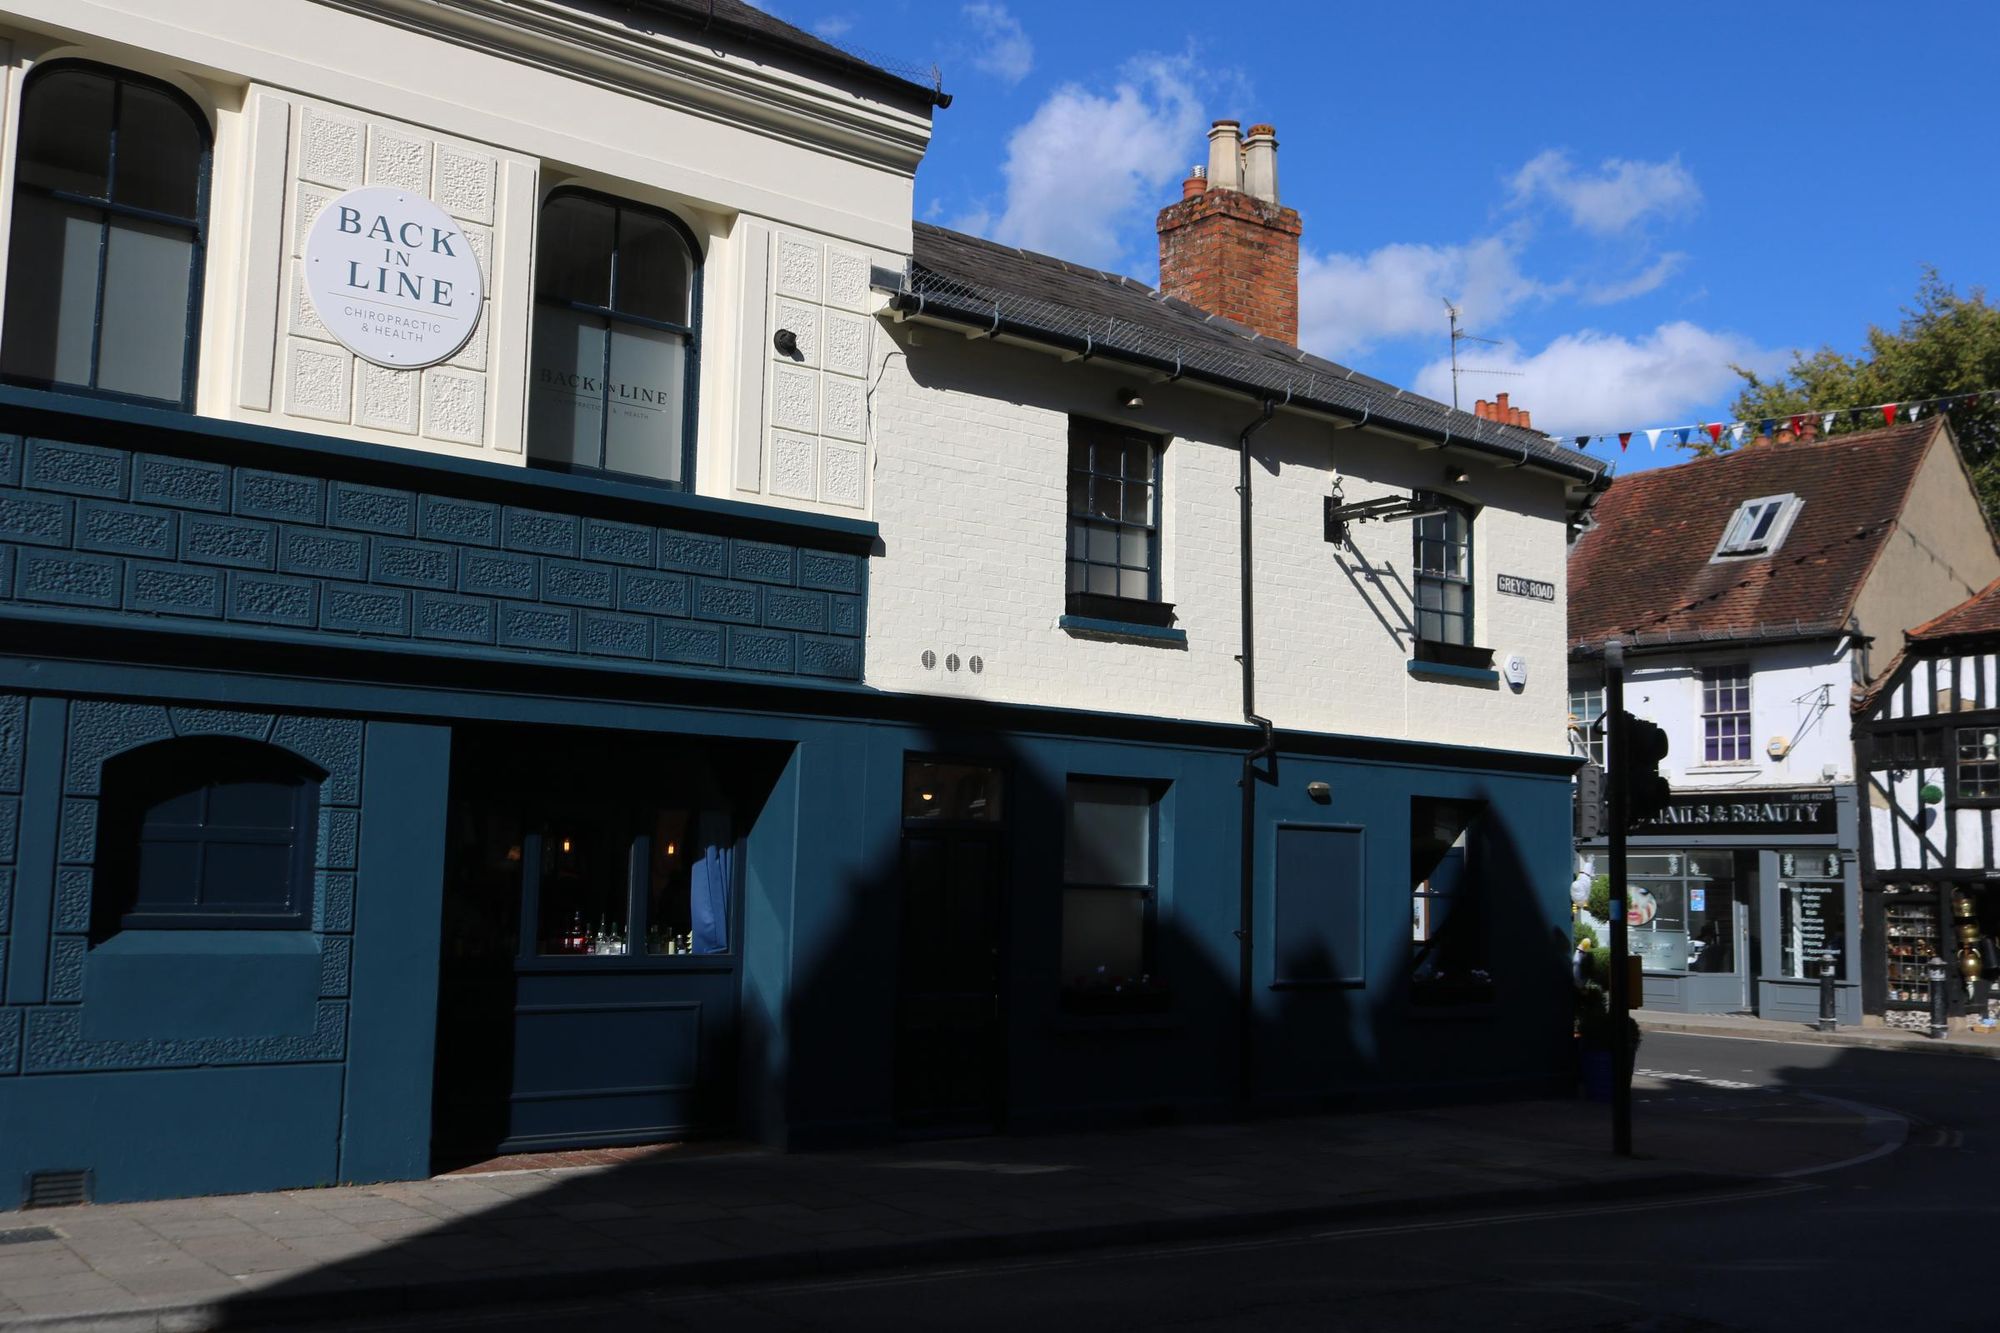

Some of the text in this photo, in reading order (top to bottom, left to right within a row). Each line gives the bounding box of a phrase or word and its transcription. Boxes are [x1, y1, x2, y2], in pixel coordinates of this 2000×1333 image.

[337, 205, 457, 257] BACK
[384, 248, 411, 267] IN
[346, 260, 453, 307] LINE
[344, 306, 441, 334] CHIROPRACTIC
[361, 322, 424, 343] & HEALTH
[541, 368, 595, 392] BACK
[620, 384, 667, 405] LINE
[1499, 576, 1553, 599] GREYS ROAD
[1713, 805, 1728, 823] &
[1731, 803, 1821, 823] BEAUTY
